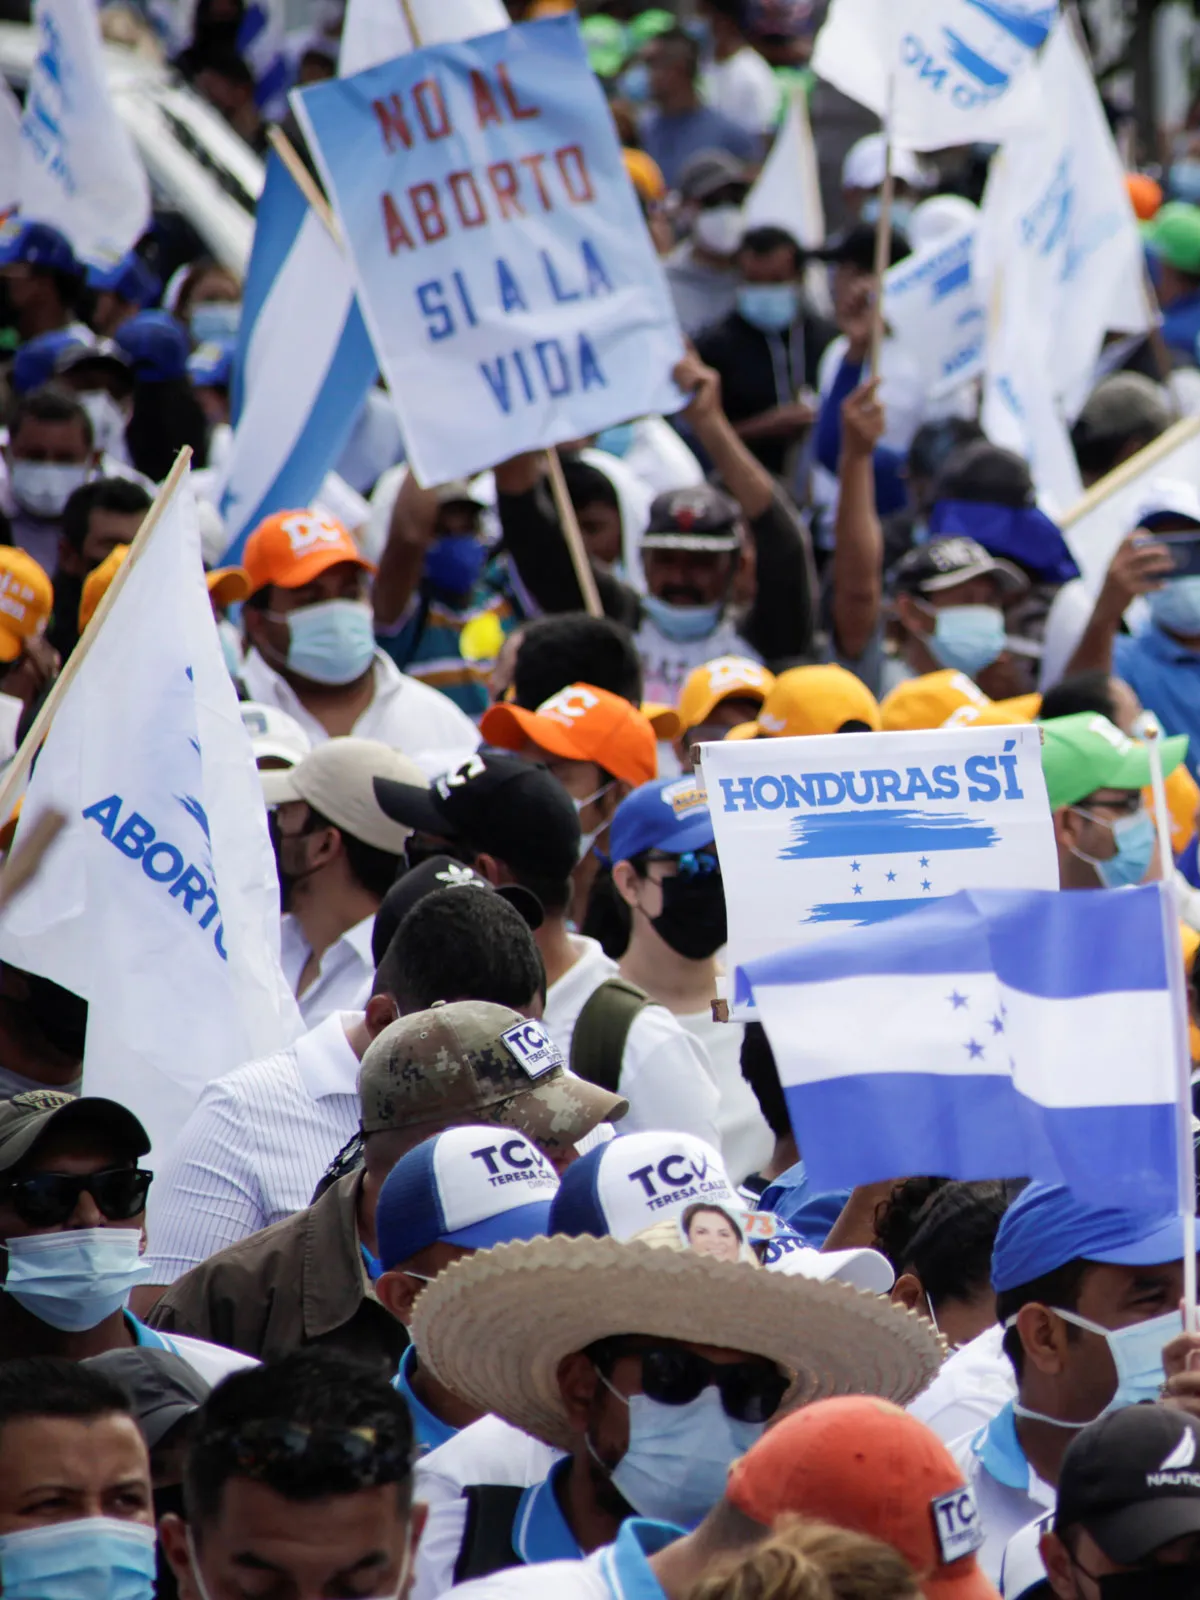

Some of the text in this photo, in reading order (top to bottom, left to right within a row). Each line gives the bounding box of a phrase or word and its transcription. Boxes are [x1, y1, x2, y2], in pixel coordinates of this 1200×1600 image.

[371, 62, 541, 152] NO AL
[379, 145, 595, 257] ABORTO
[415, 239, 615, 344] SI A LA
[478, 332, 607, 414] VIDA
[719, 765, 960, 812] HONDURAS
[964, 740, 1024, 802] SÍ
[488, 1169, 537, 1187] TERESA
[645, 1186, 697, 1212] TERESA
[740, 1212, 774, 1236] 73
